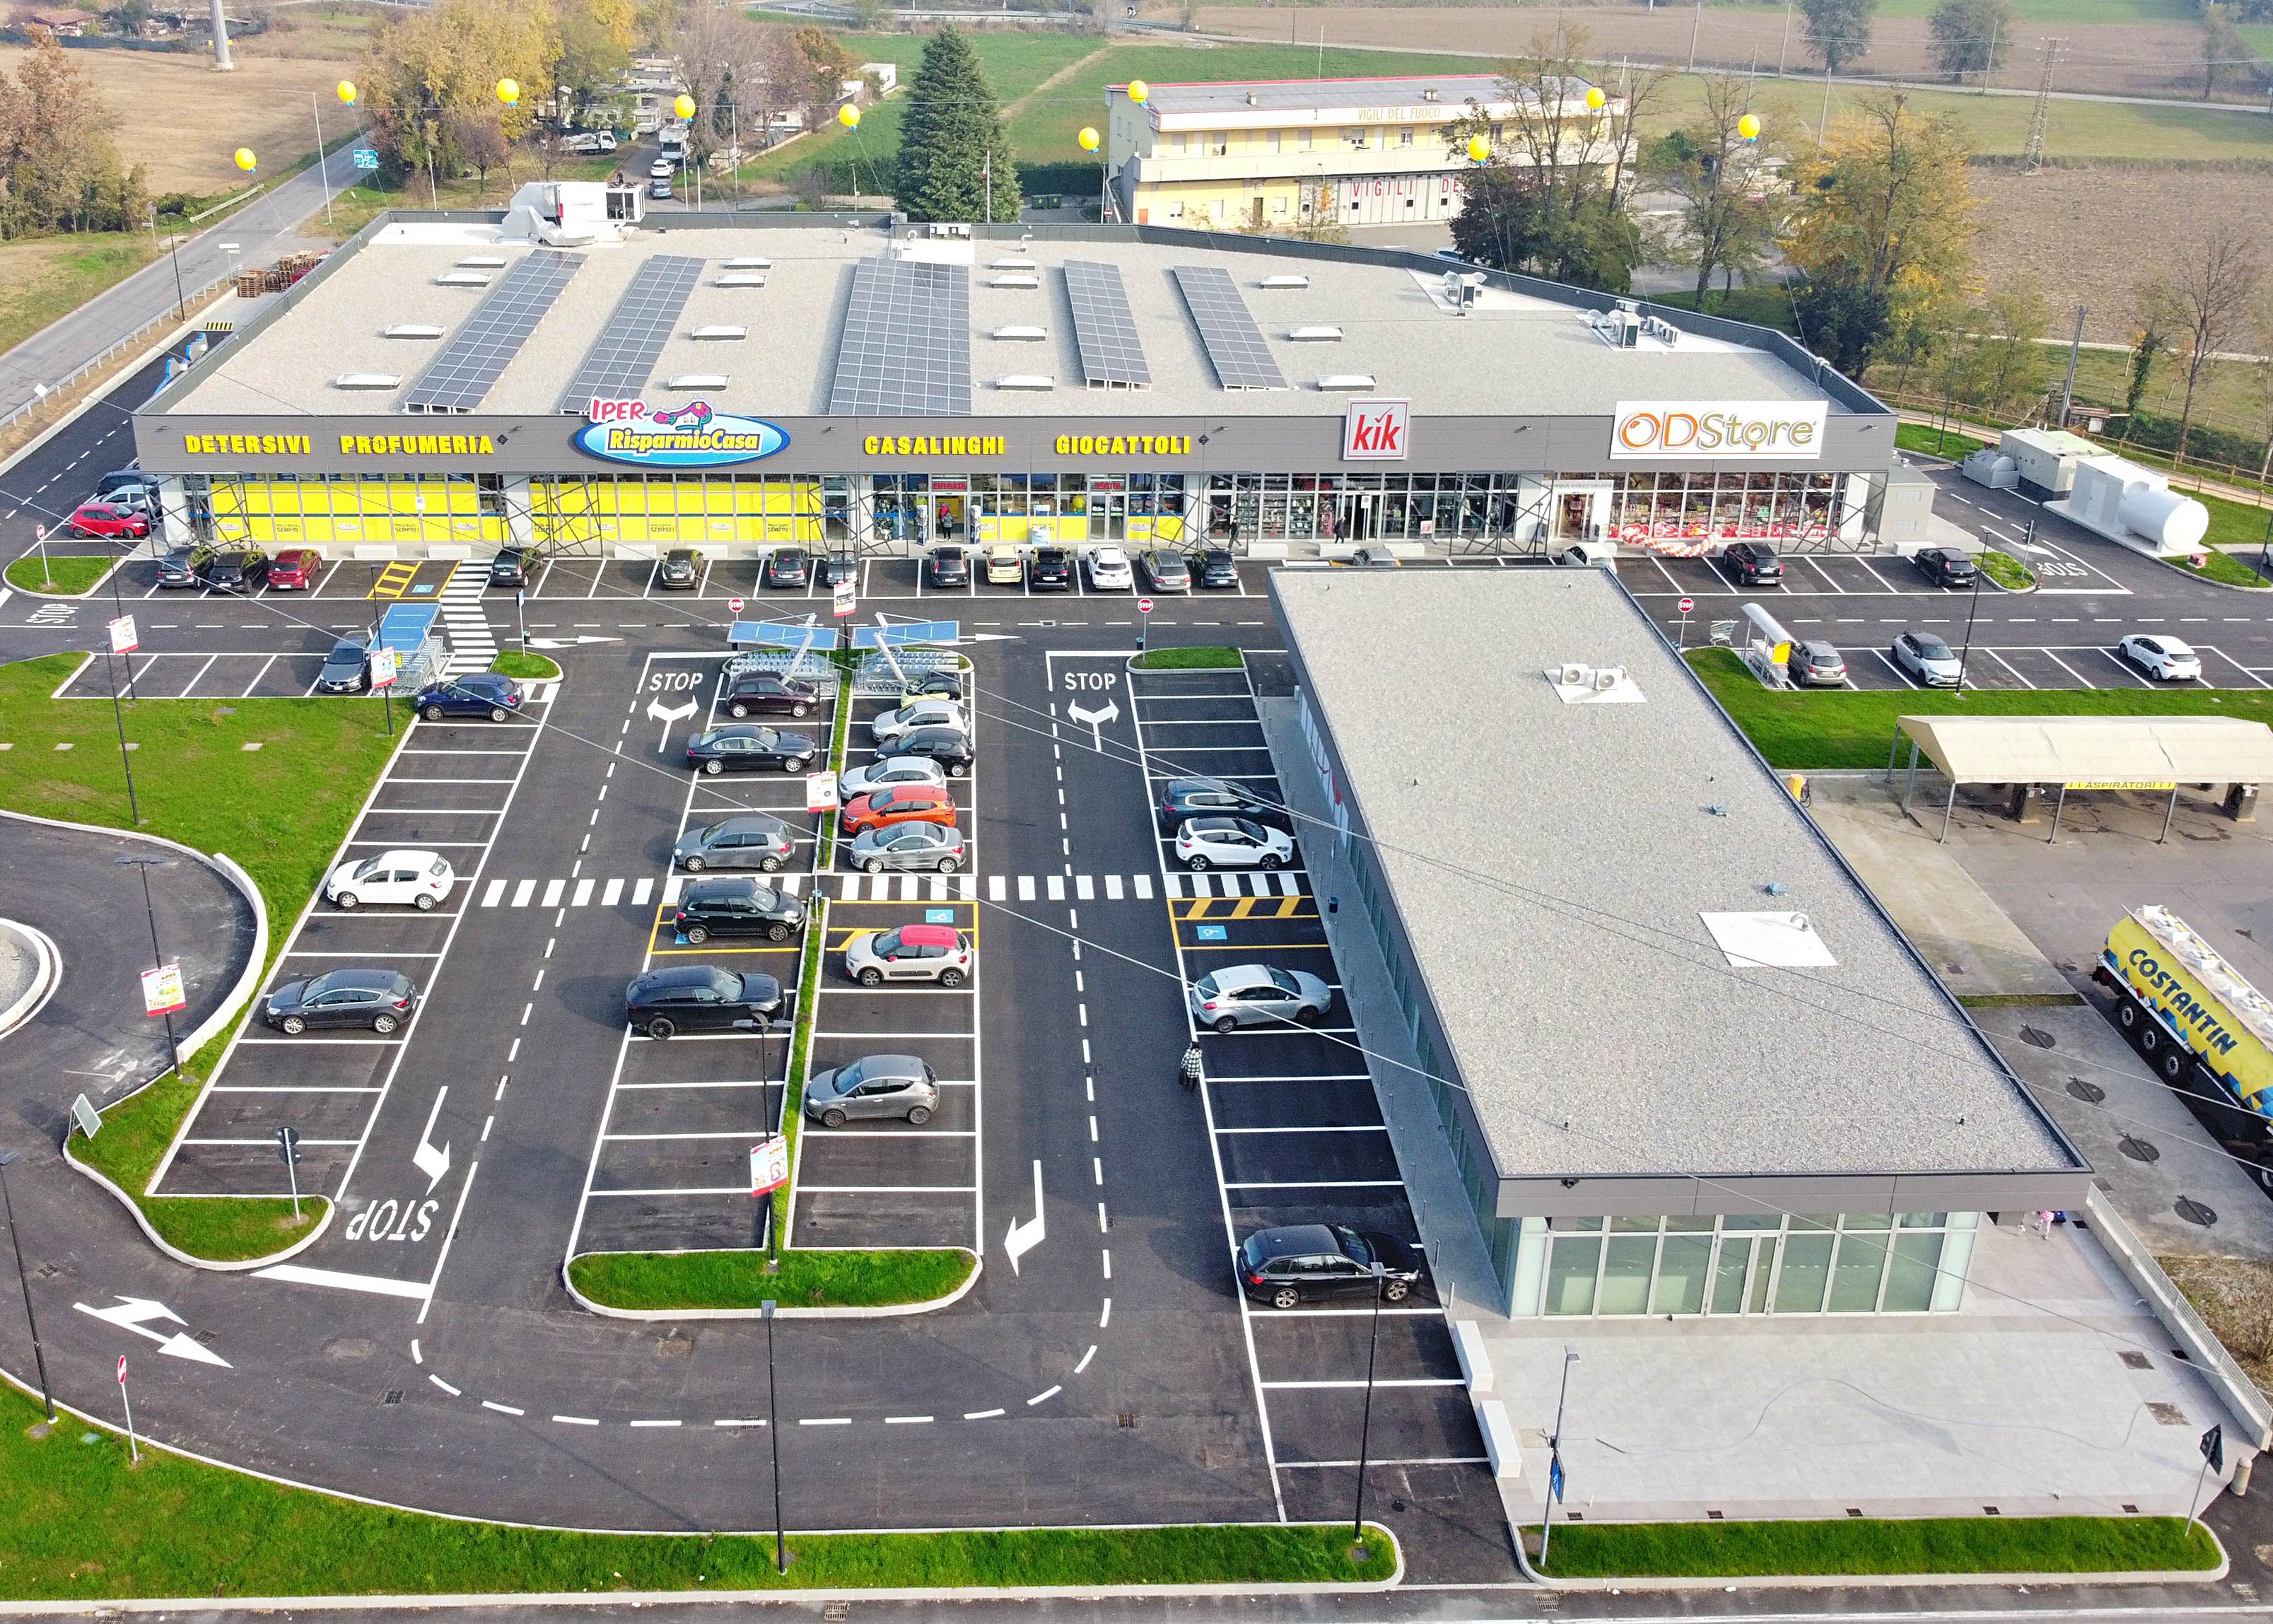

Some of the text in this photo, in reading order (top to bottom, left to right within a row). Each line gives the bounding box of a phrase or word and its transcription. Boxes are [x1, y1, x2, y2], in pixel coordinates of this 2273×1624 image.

[1358, 107, 1441, 119] VIGILI DEL FUOCO
[1353, 179, 1413, 197] VIGILI
[592, 399, 644, 420] IPER
[1352, 408, 1401, 450] kik
[1619, 411, 1816, 450] ODStore
[185, 435, 494, 454] DETERSIVI PROFUMERIA
[607, 427, 761, 454] RisparmioCasa
[864, 435, 1191, 455] CASALINGHI GIOCATTOLI
[2035, 562, 2088, 576] STOP
[25, 603, 79, 624] STOP
[649, 672, 703, 691] STOP
[1064, 672, 1116, 691] STOP
[2129, 948, 2238, 1056] COSTANTIN
[345, 1199, 440, 1242] STOP
